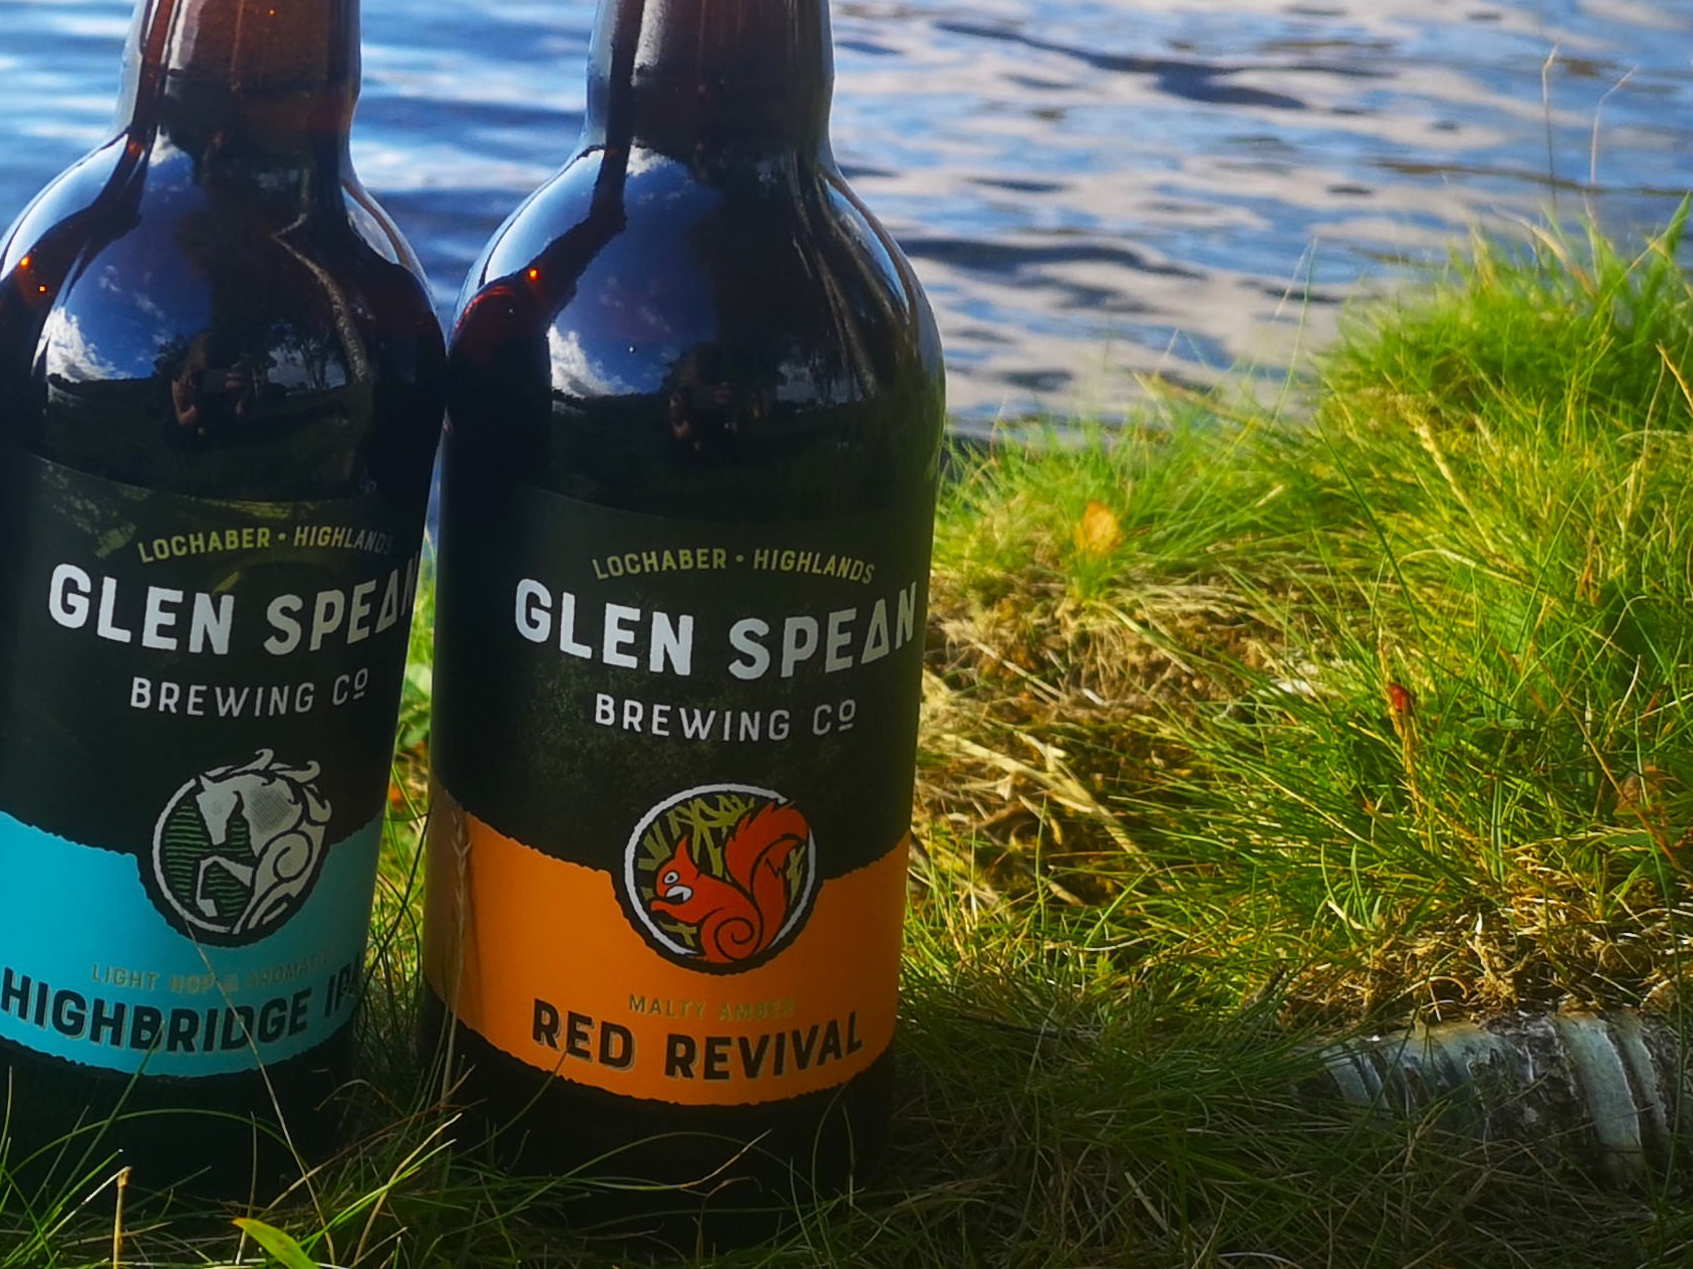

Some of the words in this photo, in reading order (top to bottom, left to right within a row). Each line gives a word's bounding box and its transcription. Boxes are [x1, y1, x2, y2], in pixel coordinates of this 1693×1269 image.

[136, 526, 271, 564] LOCHABER
[293, 526, 394, 556] HIGHLANDS
[592, 549, 727, 580] LOCHABER
[753, 549, 875, 585] HIGHLANDS
[48, 563, 234, 655] GLEN
[515, 579, 694, 676] GLEN
[728, 581, 917, 680] SPEAN
[130, 677, 315, 717] BREWING
[595, 693, 790, 742] BREWING
[92, 963, 159, 992] LIGHT
[1, 968, 313, 1055] HIGHBRIDGE
[628, 994, 706, 1019] MALTY
[718, 997, 797, 1021] AMBER
[531, 998, 636, 1072] RED
[664, 1010, 864, 1081] REVIVAL
